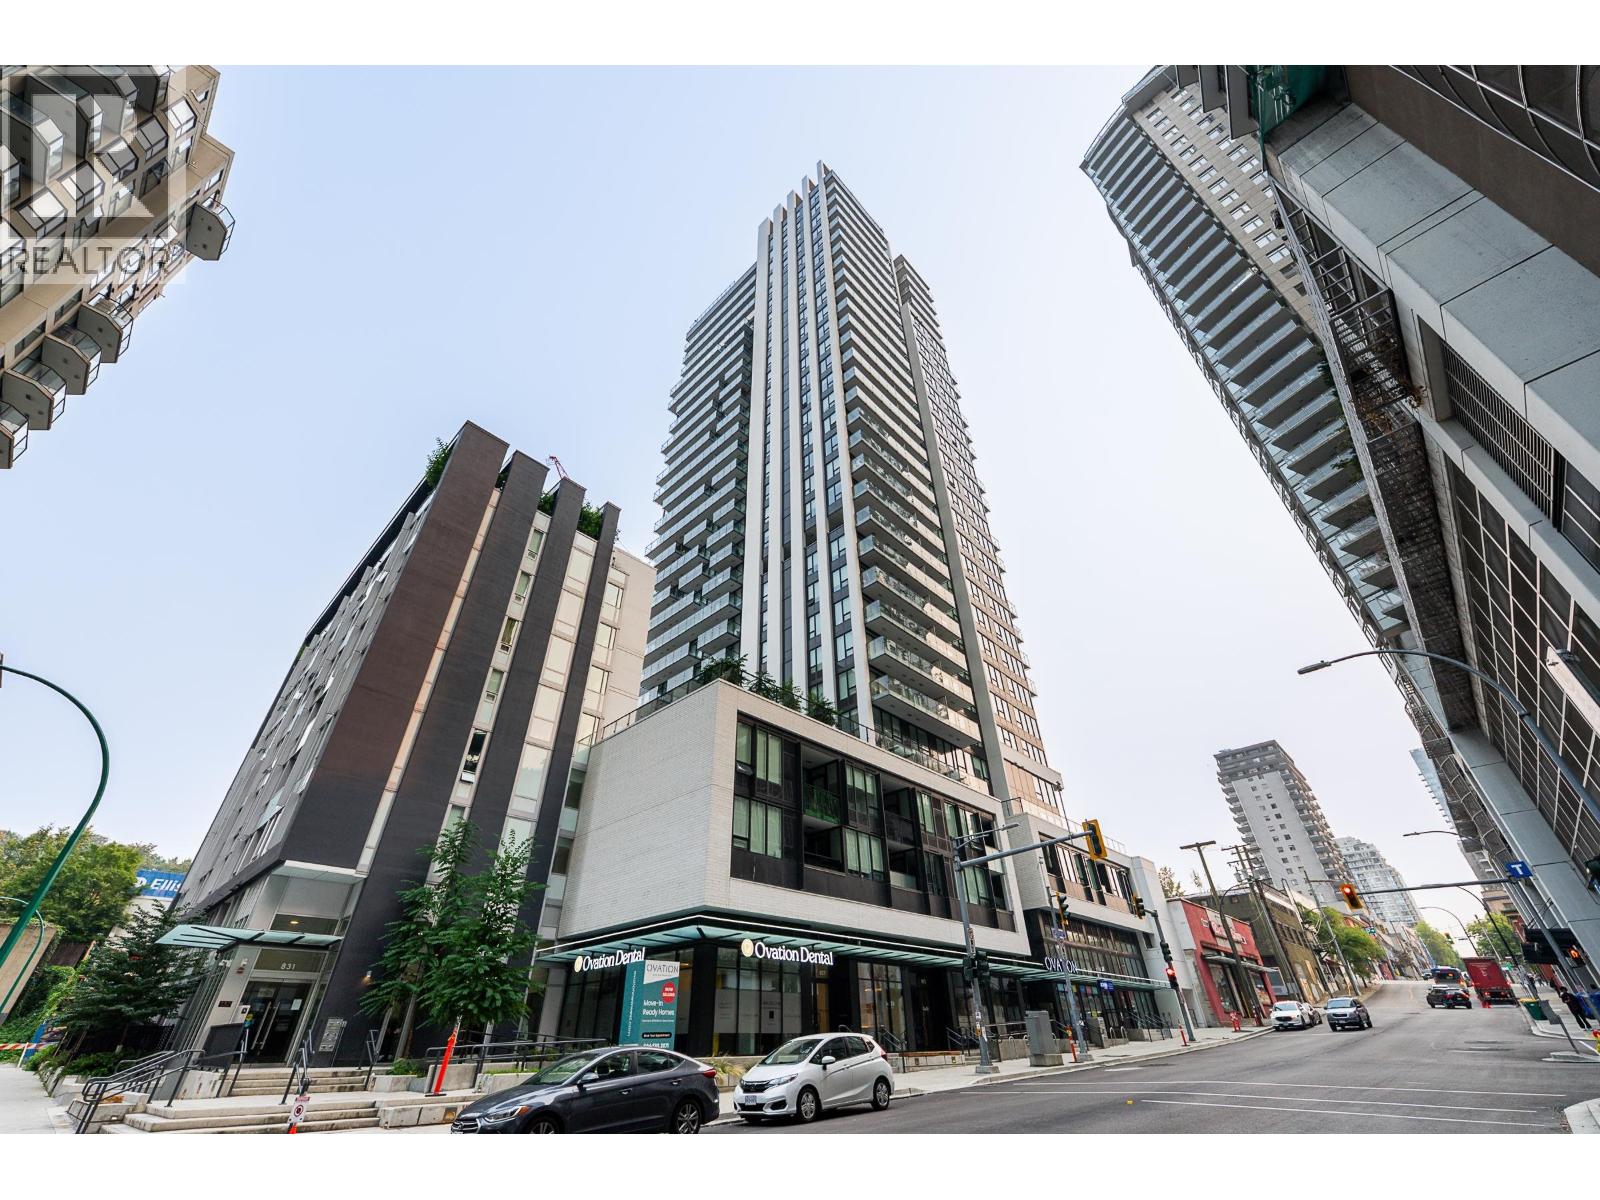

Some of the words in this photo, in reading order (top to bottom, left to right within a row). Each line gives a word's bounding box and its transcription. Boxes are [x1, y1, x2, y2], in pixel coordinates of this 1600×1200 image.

[582, 953, 614, 972] Ovation
[614, 946, 646, 966] Dental
[754, 941, 800, 962] Ovation
[800, 946, 834, 966] Dental
[280, 962, 296, 971] 831
[646, 963, 679, 973] OVATION
[1044, 956, 1079, 974] OVAON
